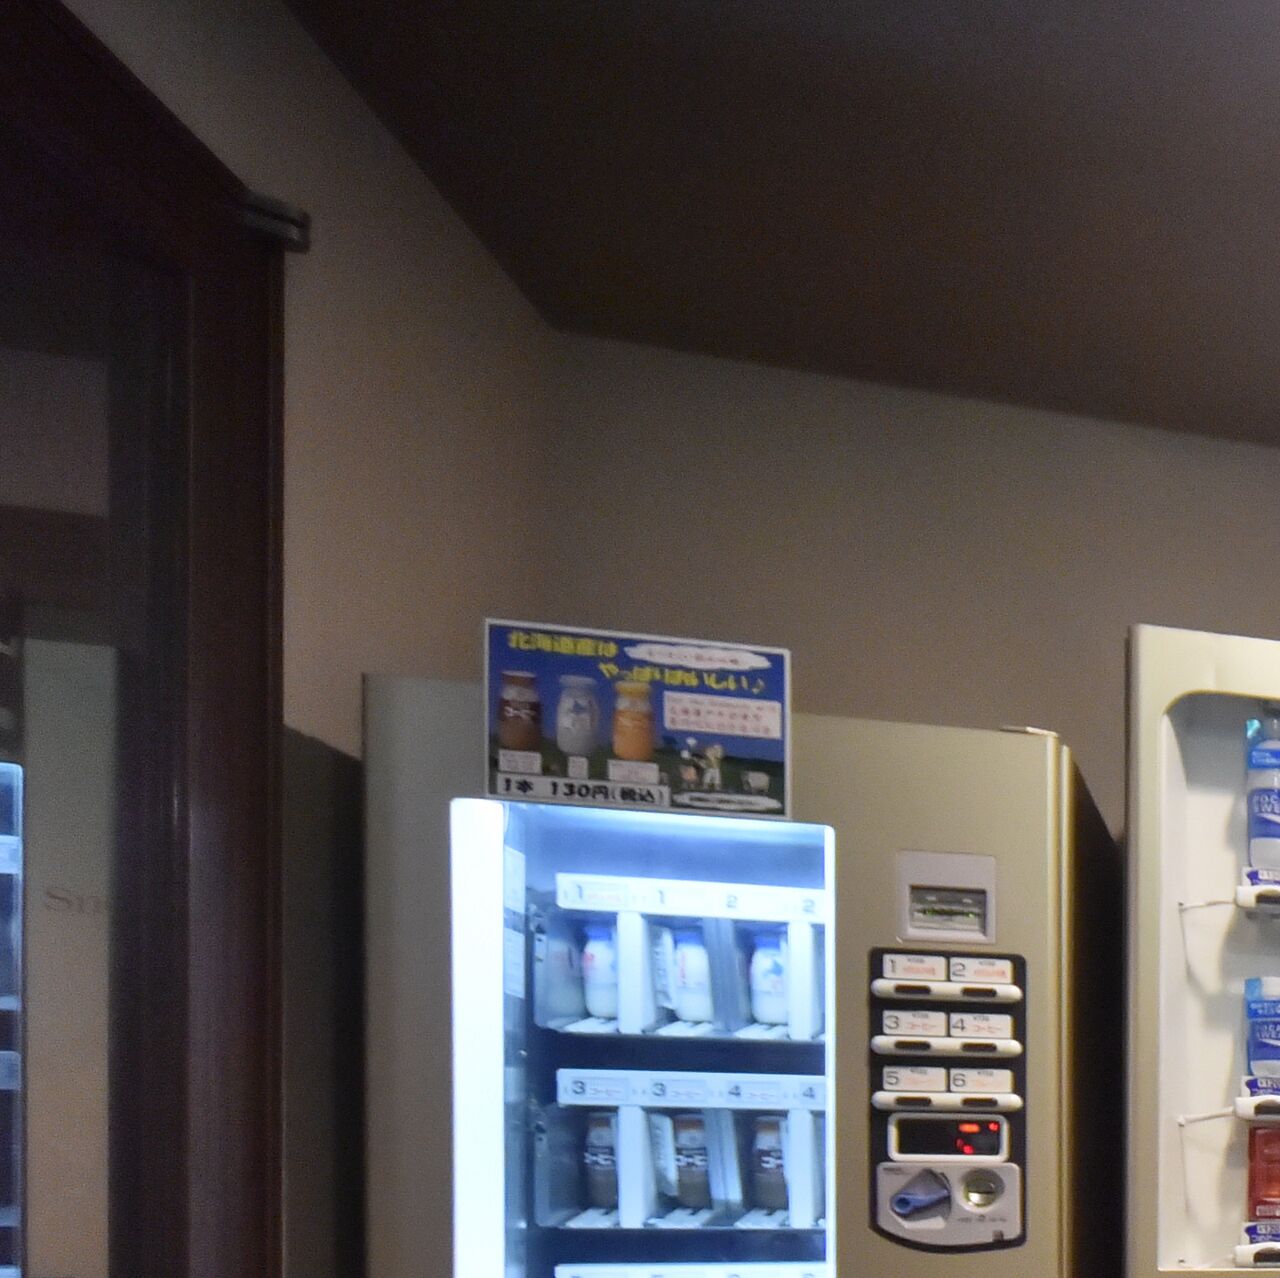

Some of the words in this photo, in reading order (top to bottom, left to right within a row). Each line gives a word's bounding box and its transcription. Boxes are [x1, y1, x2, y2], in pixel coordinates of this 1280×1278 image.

[888, 959, 897, 974] 1
[952, 962, 966, 977] 2
[884, 1015, 900, 1030] 3
[952, 1017, 966, 1032] 4
[885, 1070, 900, 1085] 5
[952, 1072, 966, 1087] 6
[572, 1081, 586, 1095] 3
[653, 1083, 667, 1096] 3
[728, 1085, 742, 1098] 4
[803, 1088, 816, 1100] 4
